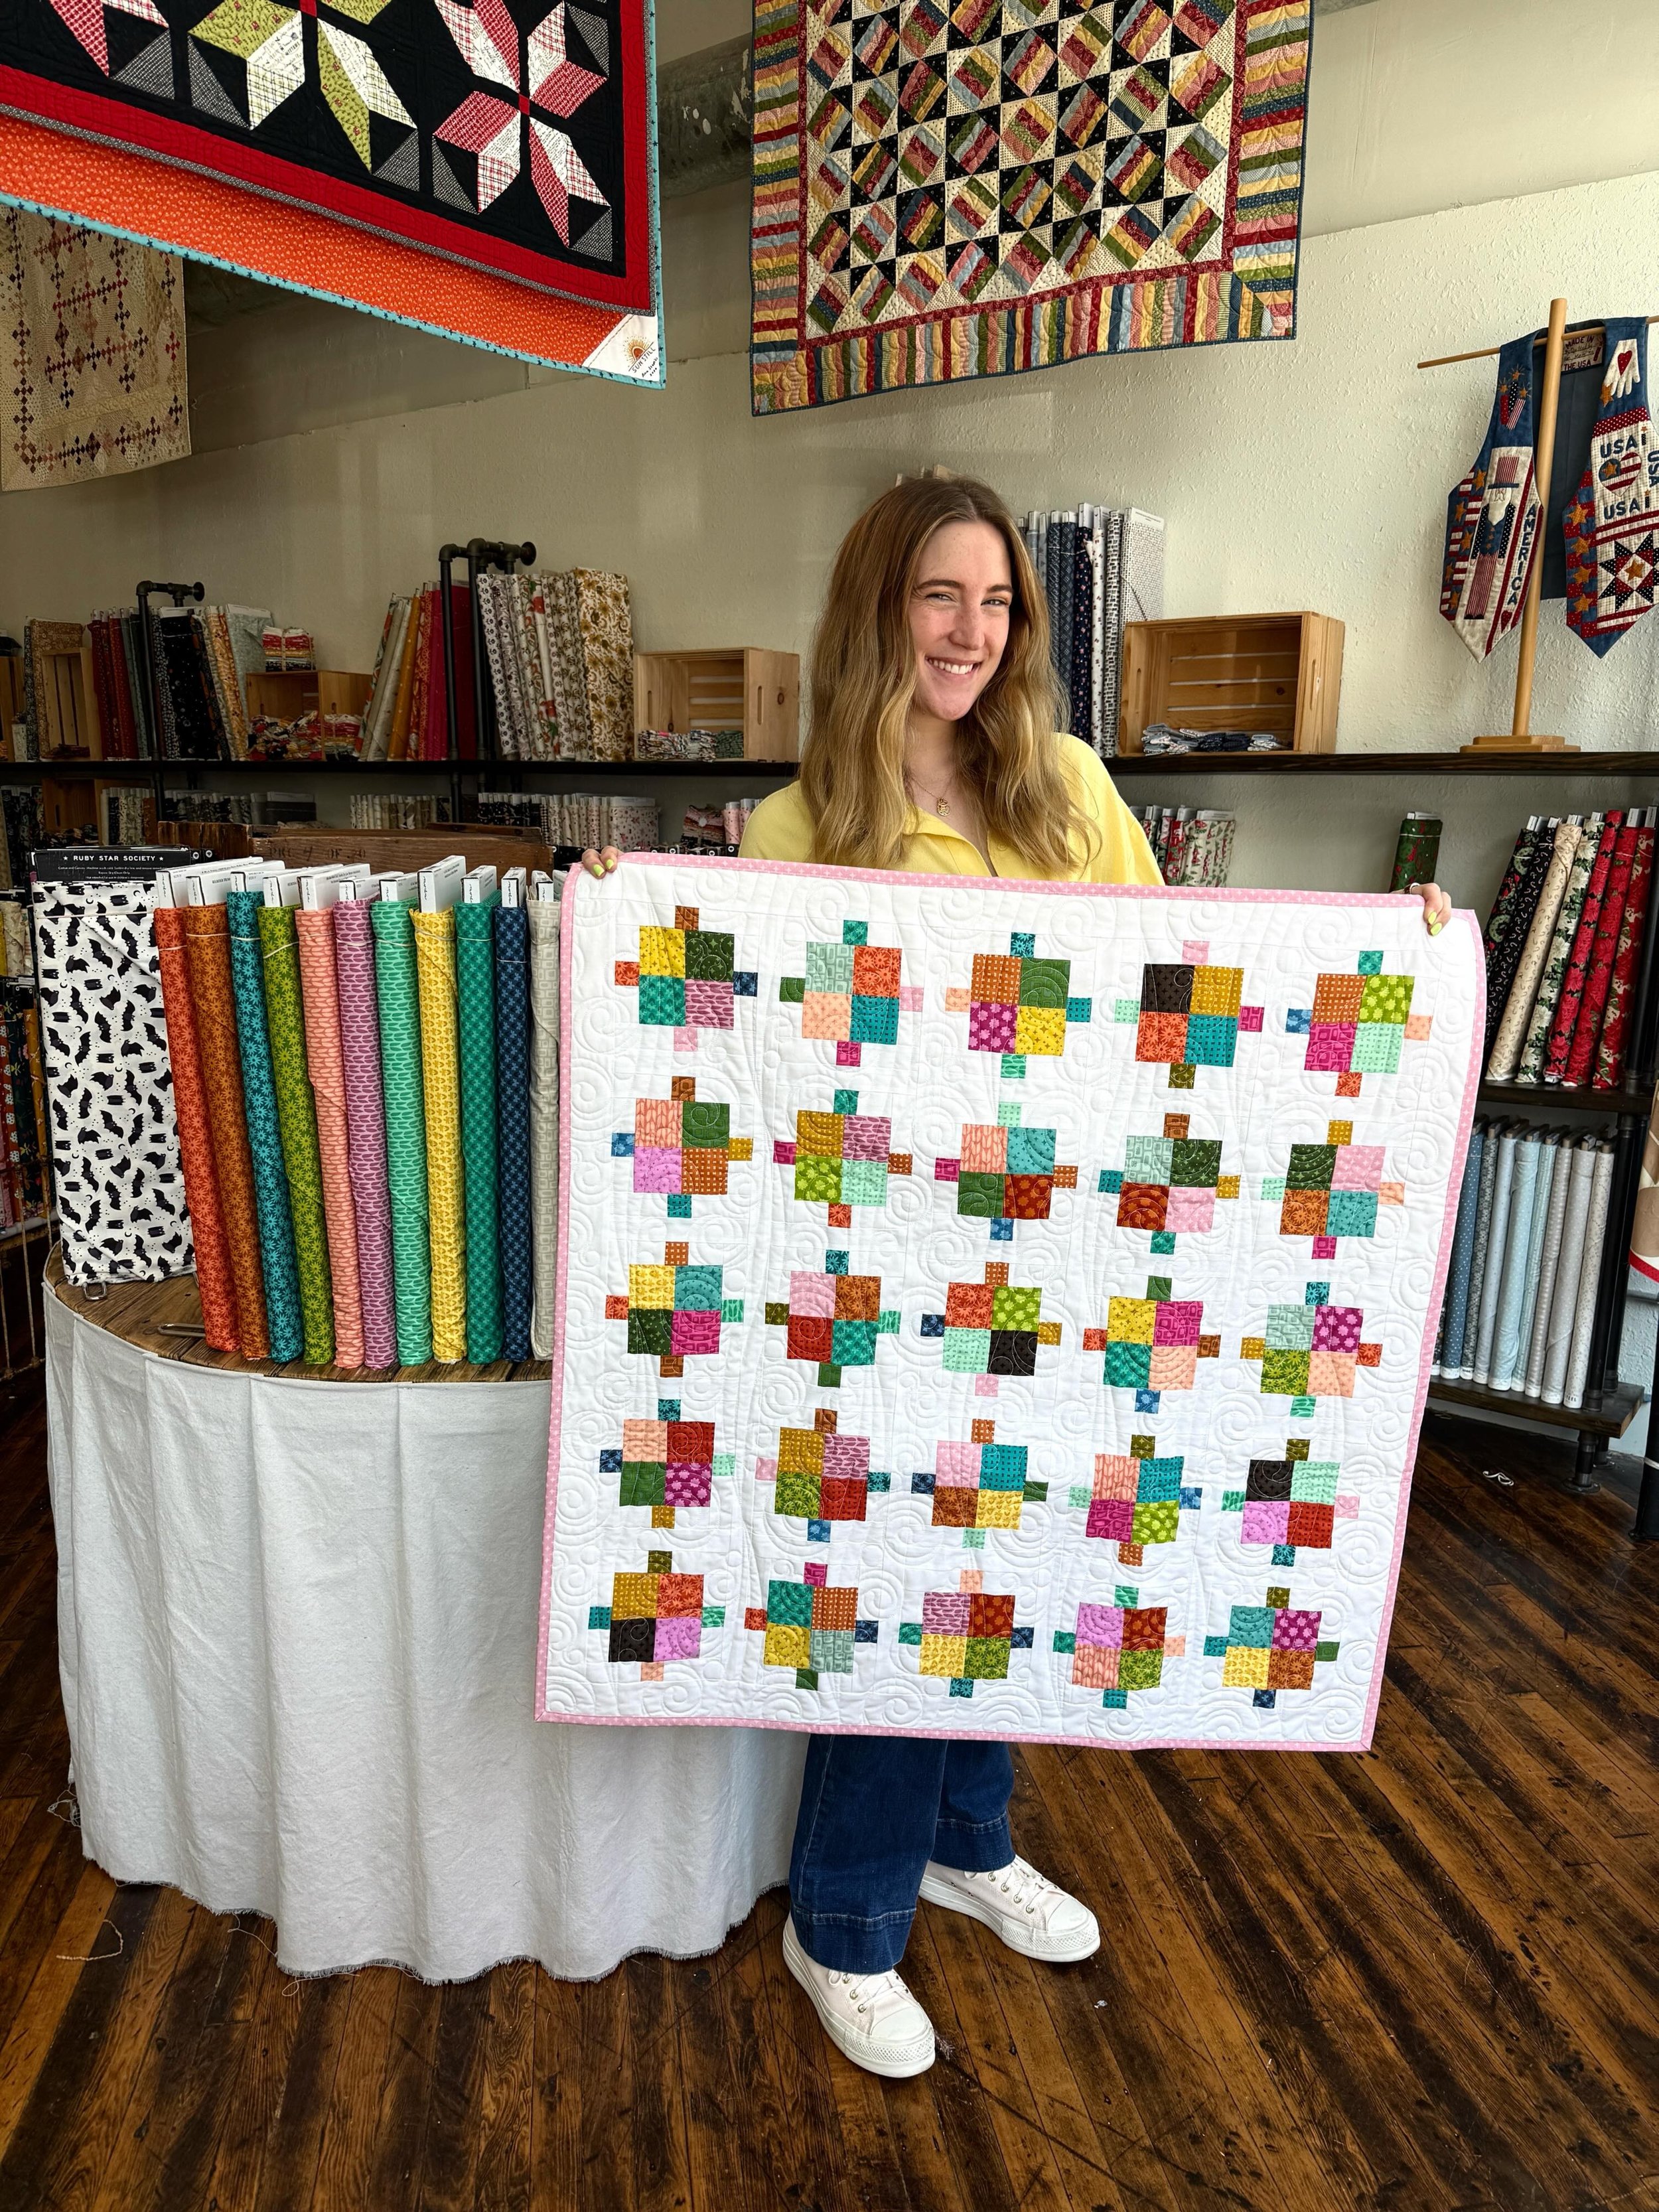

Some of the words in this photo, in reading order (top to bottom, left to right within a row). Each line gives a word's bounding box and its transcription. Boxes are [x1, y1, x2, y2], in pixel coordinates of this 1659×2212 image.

[1565, 336, 1585, 349] MADE
[1577, 359, 1591, 369] USA
[1600, 435, 1638, 458] USA
[1648, 450, 1659, 488] USA
[1603, 498, 1640, 520] USA
[1507, 503, 1536, 606] AMERICA
